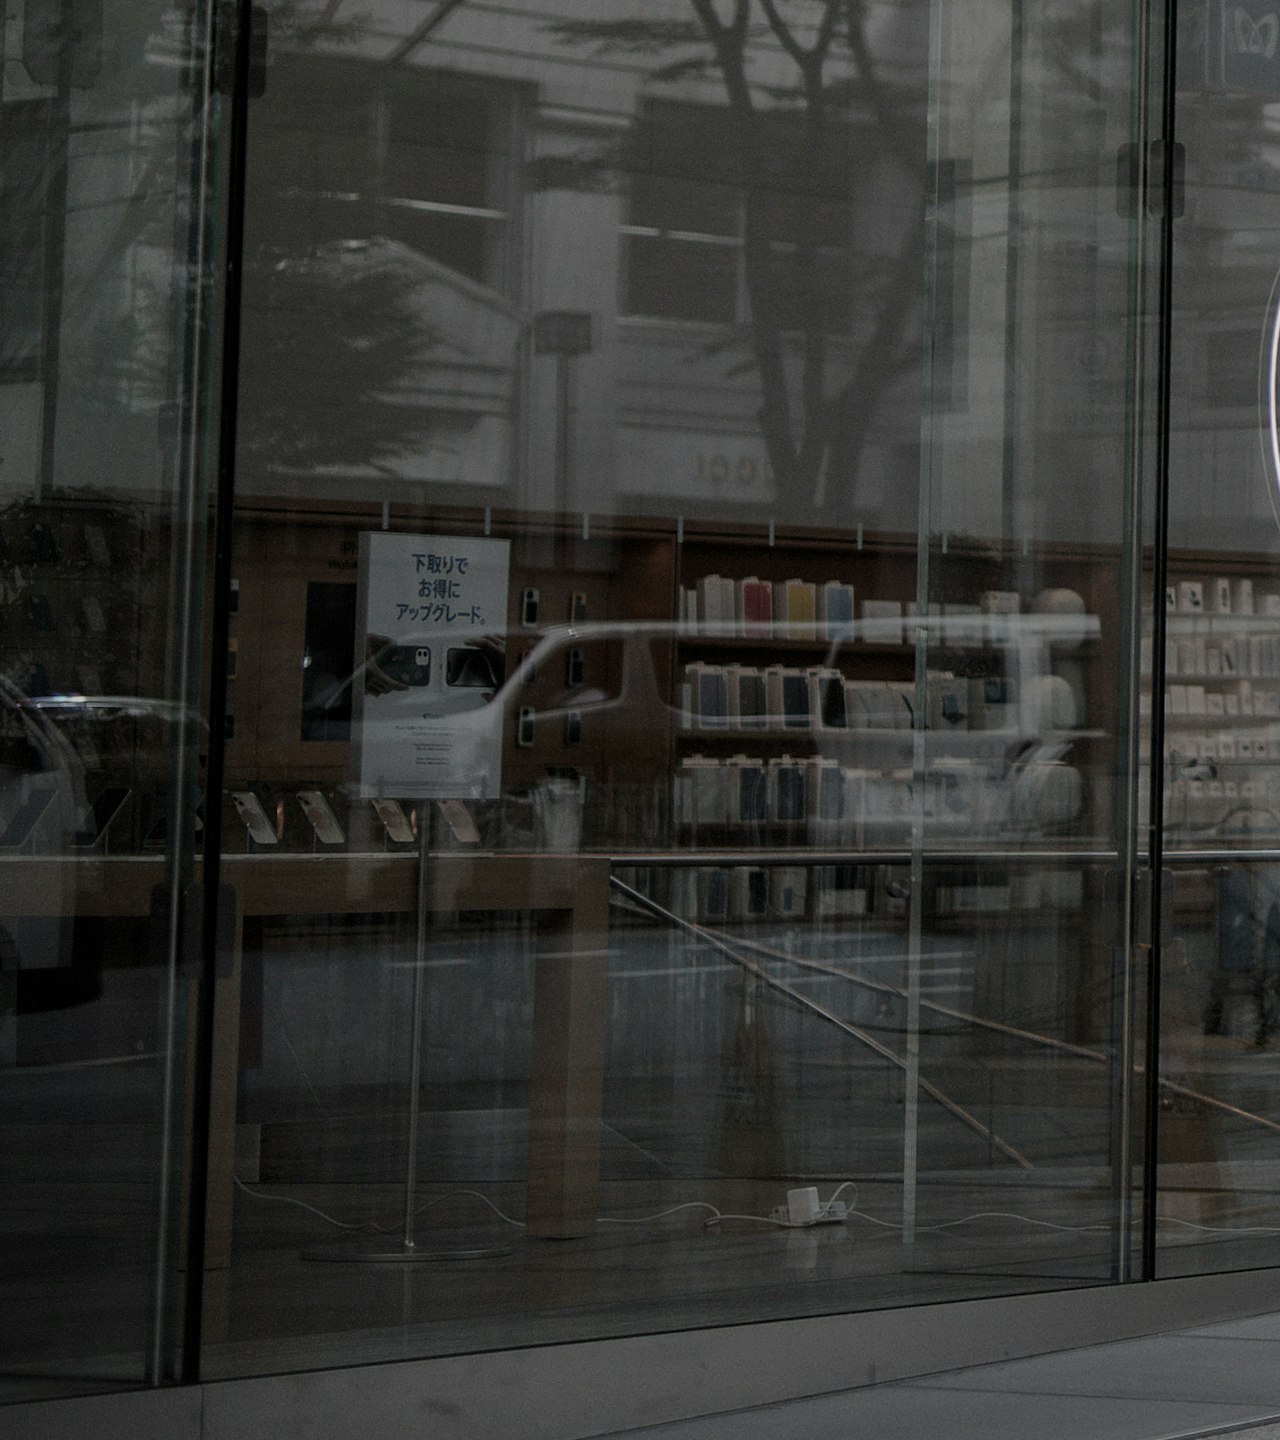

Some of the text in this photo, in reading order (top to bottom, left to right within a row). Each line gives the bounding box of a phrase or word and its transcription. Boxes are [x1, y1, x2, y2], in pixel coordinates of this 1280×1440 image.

[411, 553, 469, 574] 下取りで
[418, 578, 461, 599] お得に
